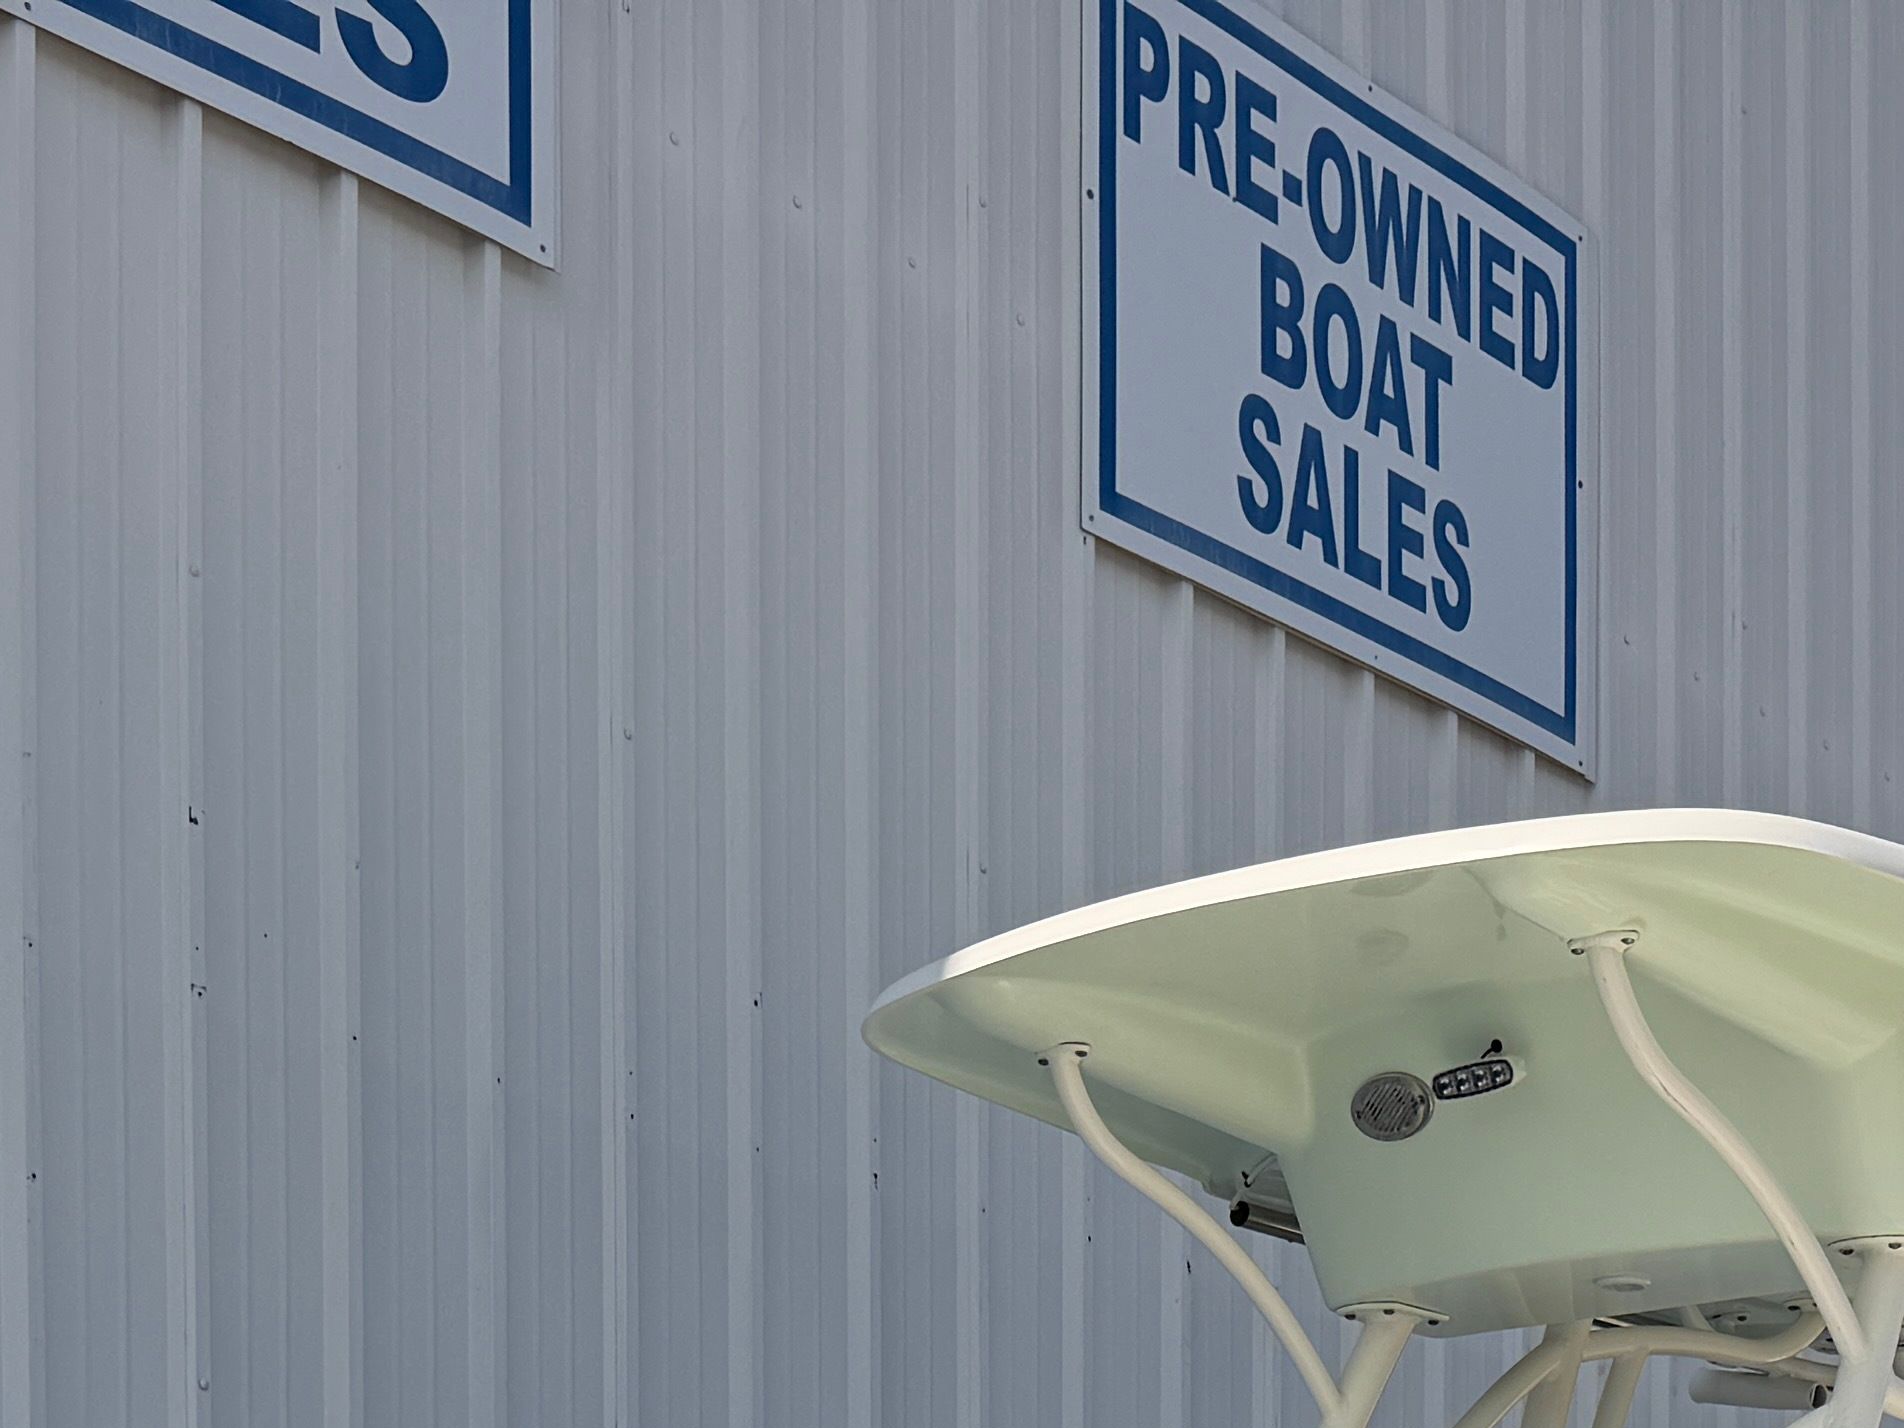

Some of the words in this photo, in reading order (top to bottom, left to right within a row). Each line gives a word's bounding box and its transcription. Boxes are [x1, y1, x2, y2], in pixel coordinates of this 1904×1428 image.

[1123, 3, 1560, 390] PRE-OWNED
[1260, 242, 1453, 472] BOAT
[1237, 393, 1472, 632] SALES
